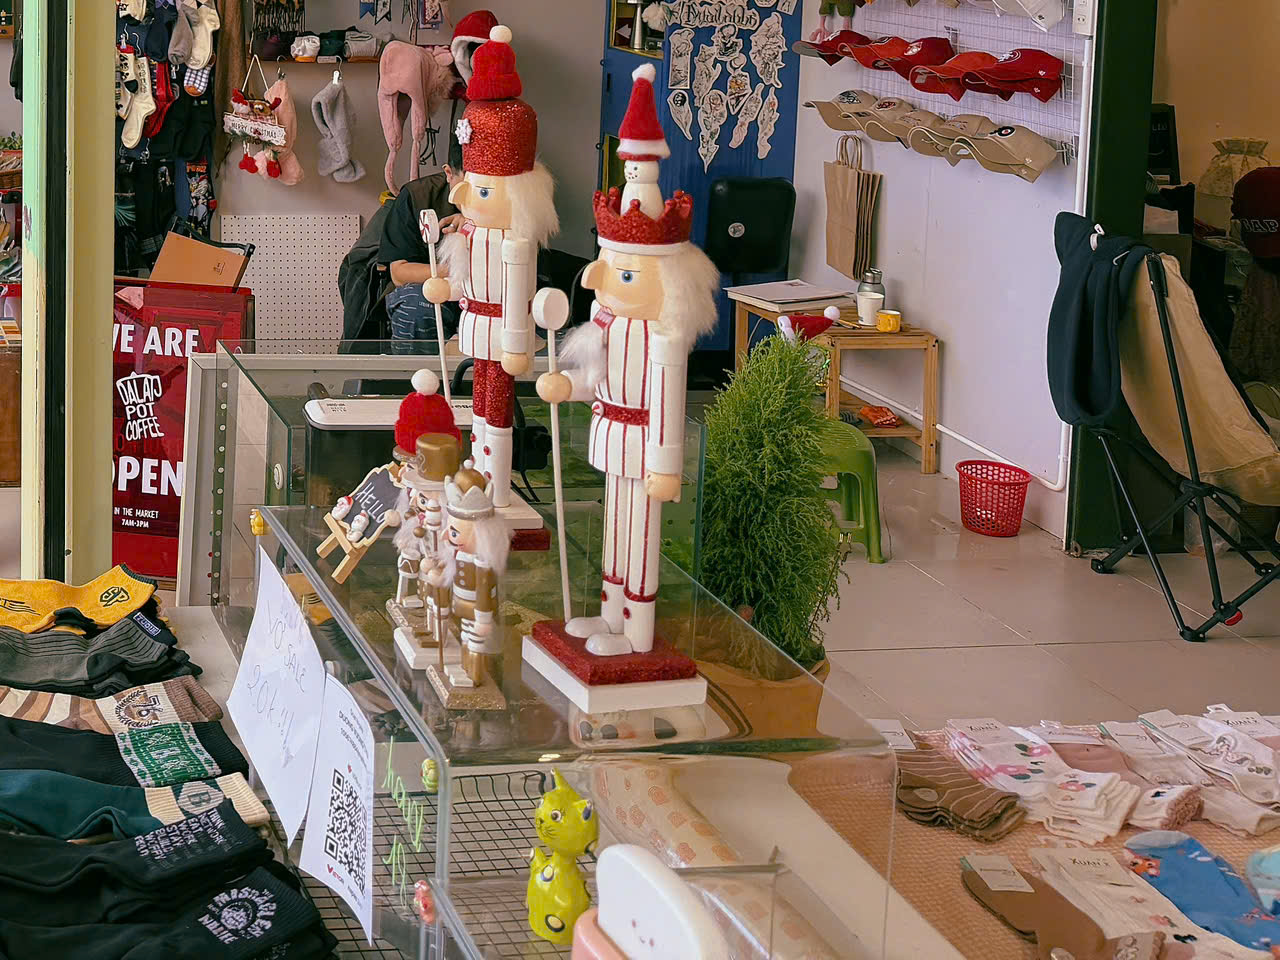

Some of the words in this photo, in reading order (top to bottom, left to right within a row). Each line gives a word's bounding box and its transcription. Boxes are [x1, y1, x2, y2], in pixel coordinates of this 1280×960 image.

[113, 323, 135, 353] E
[142, 326, 200, 357] ARE
[125, 402, 156, 421] POT
[125, 417, 165, 442] COFFEE
[114, 455, 183, 497] PEN
[122, 507, 133, 517] THE
[135, 509, 159, 519] MARKET
[165, 824, 186, 847] STAY
[187, 817, 204, 834] EAT
